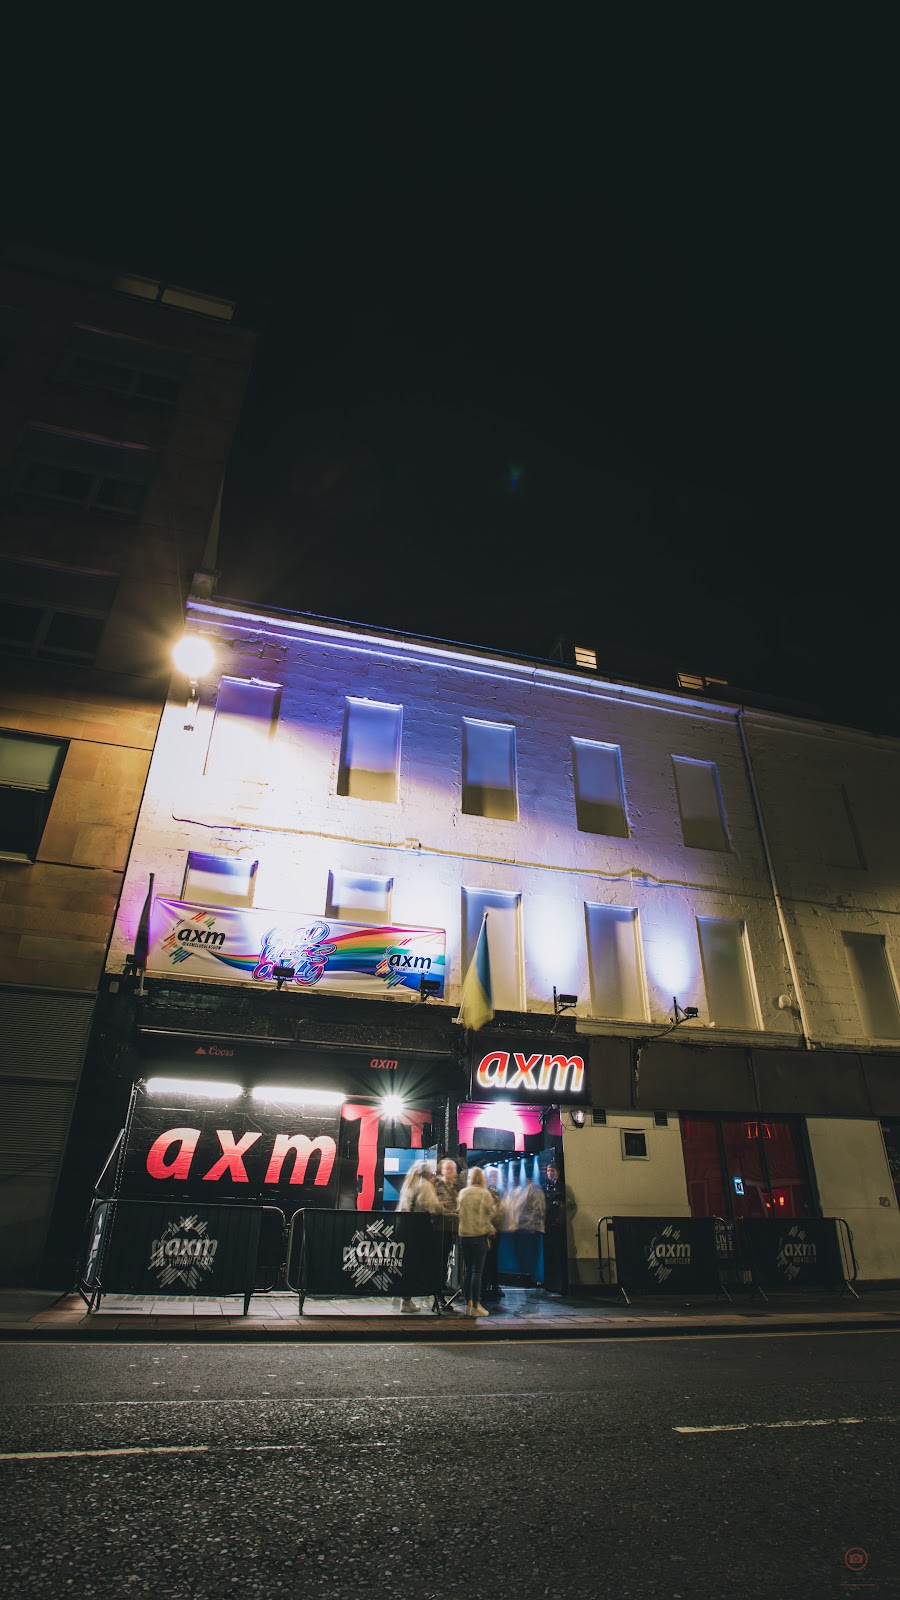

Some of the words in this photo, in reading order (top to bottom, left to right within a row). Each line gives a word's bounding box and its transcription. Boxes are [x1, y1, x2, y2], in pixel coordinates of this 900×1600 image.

[177, 928, 226, 946] axm
[389, 954, 432, 970] axm
[208, 1045, 235, 1057] Coors
[369, 1058, 399, 1070] axm
[476, 1050, 585, 1092] axm
[146, 1127, 337, 1186] axm
[165, 1238, 219, 1257] axm
[355, 1240, 406, 1258] axm
[655, 1243, 691, 1258] axm
[784, 1243, 817, 1257] axm
[367, 1257, 403, 1268] NIGHTCLUB
